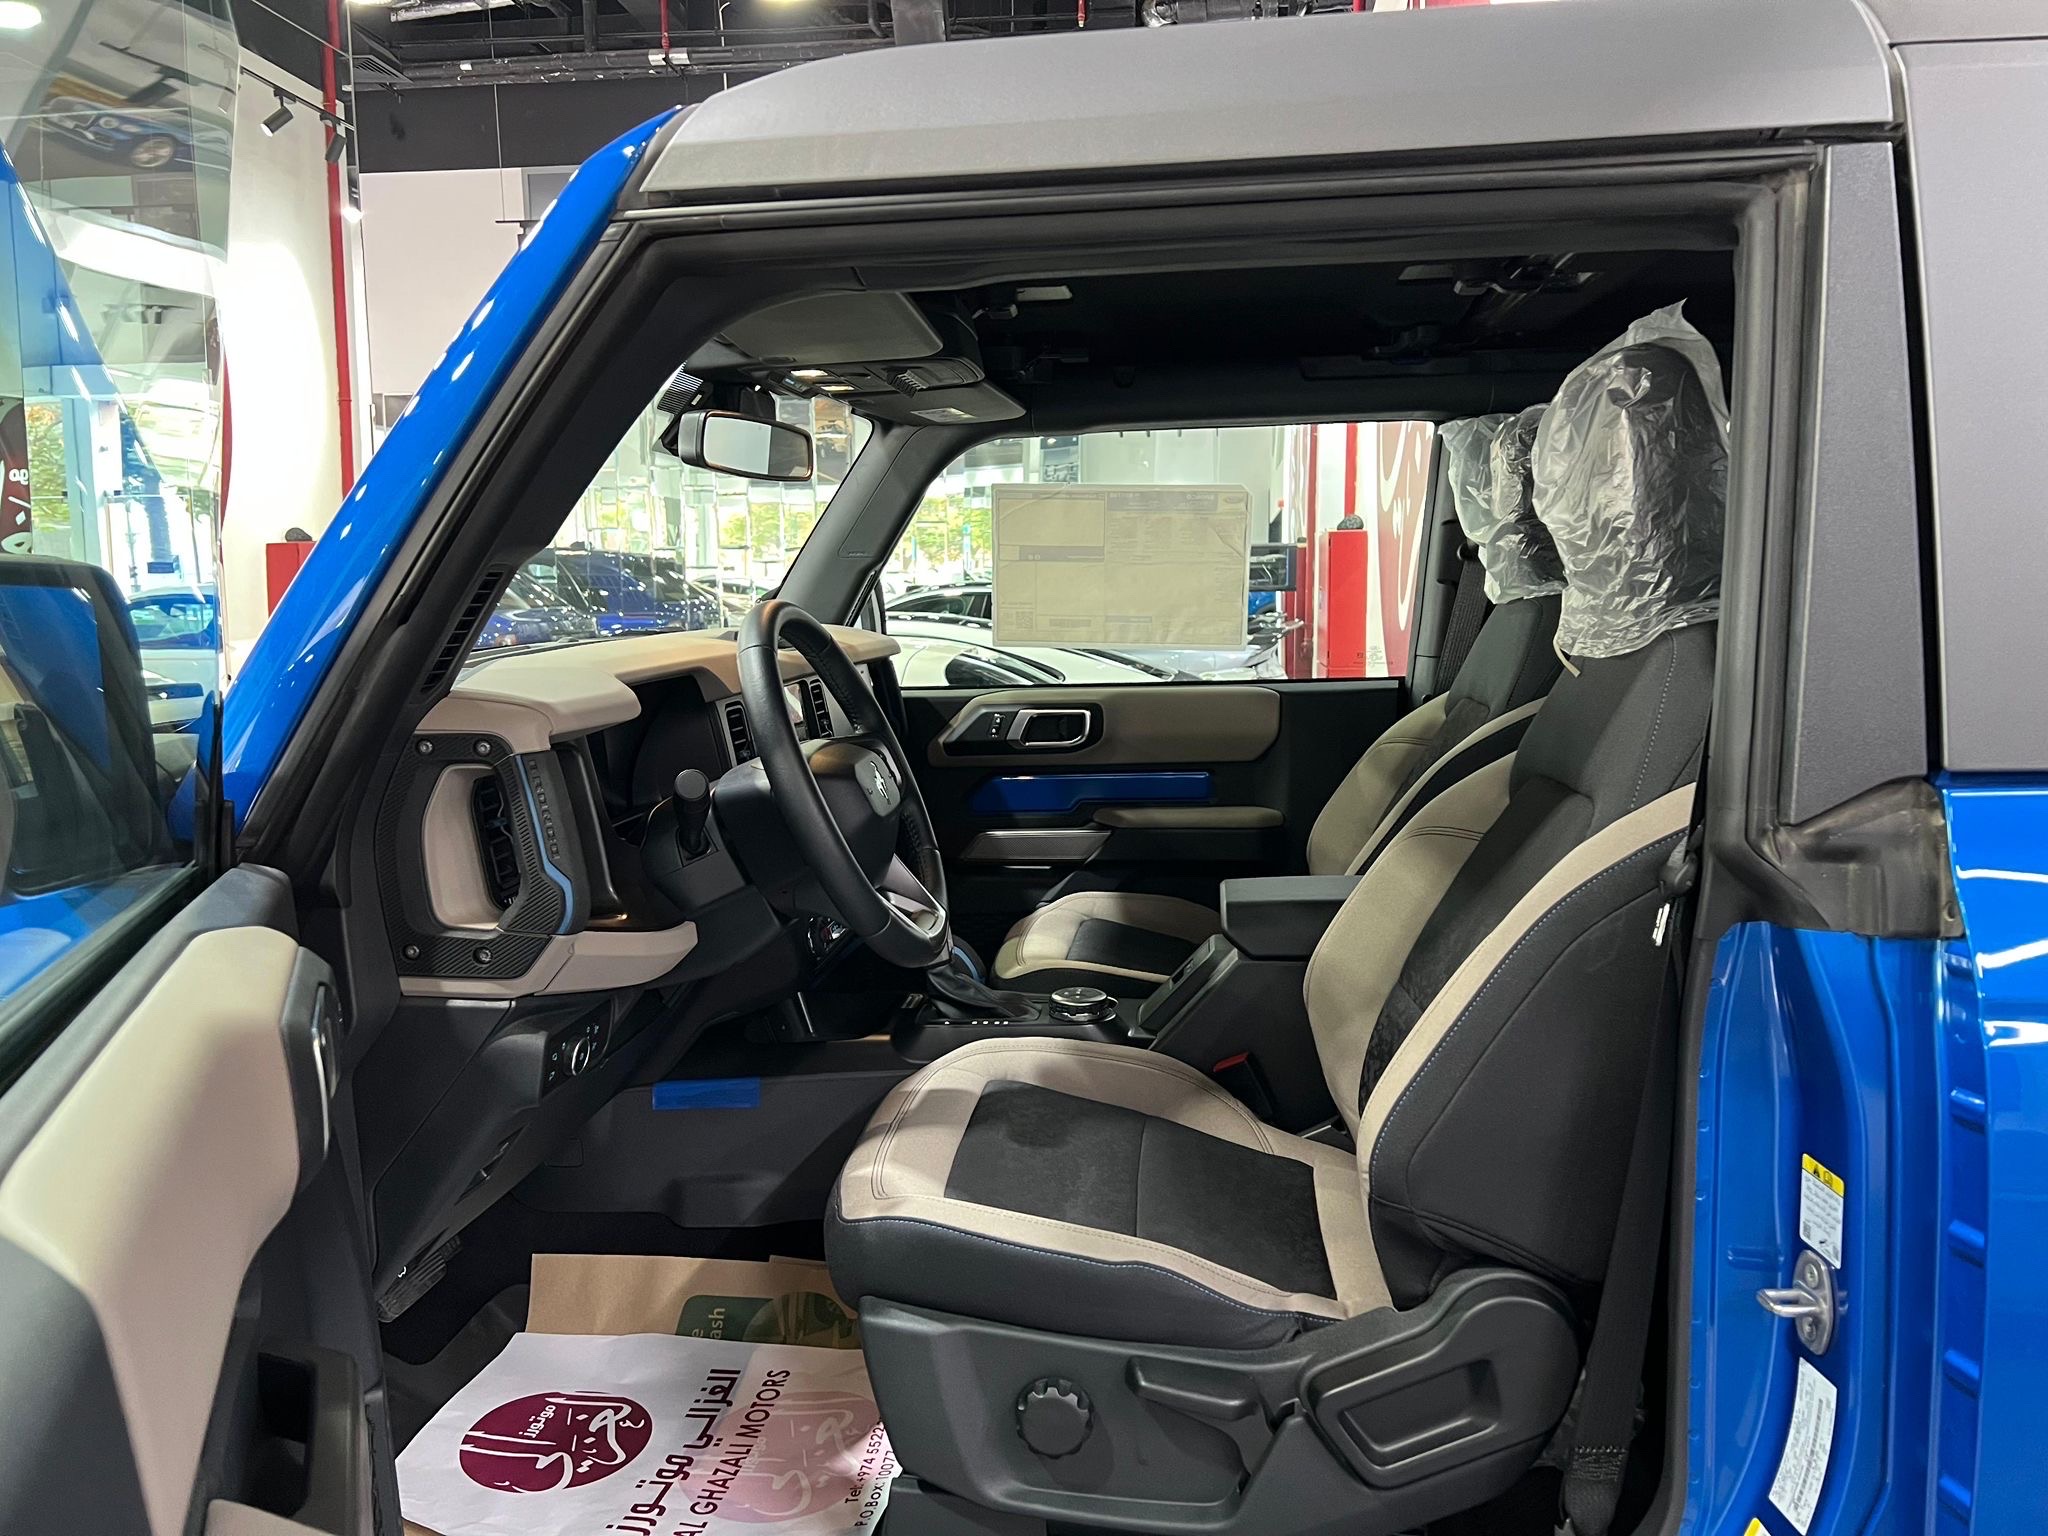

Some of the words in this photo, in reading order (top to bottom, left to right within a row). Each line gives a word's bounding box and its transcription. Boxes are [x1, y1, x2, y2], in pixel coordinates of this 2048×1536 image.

[708, 1307, 726, 1339] ash
[518, 1404, 556, 1438] موتورز
[683, 1368, 742, 1450] الغزالي
[689, 1444, 754, 1515] GHAZALI
[742, 1369, 791, 1440] MOTORS
[605, 1453, 695, 1536] موتورز
